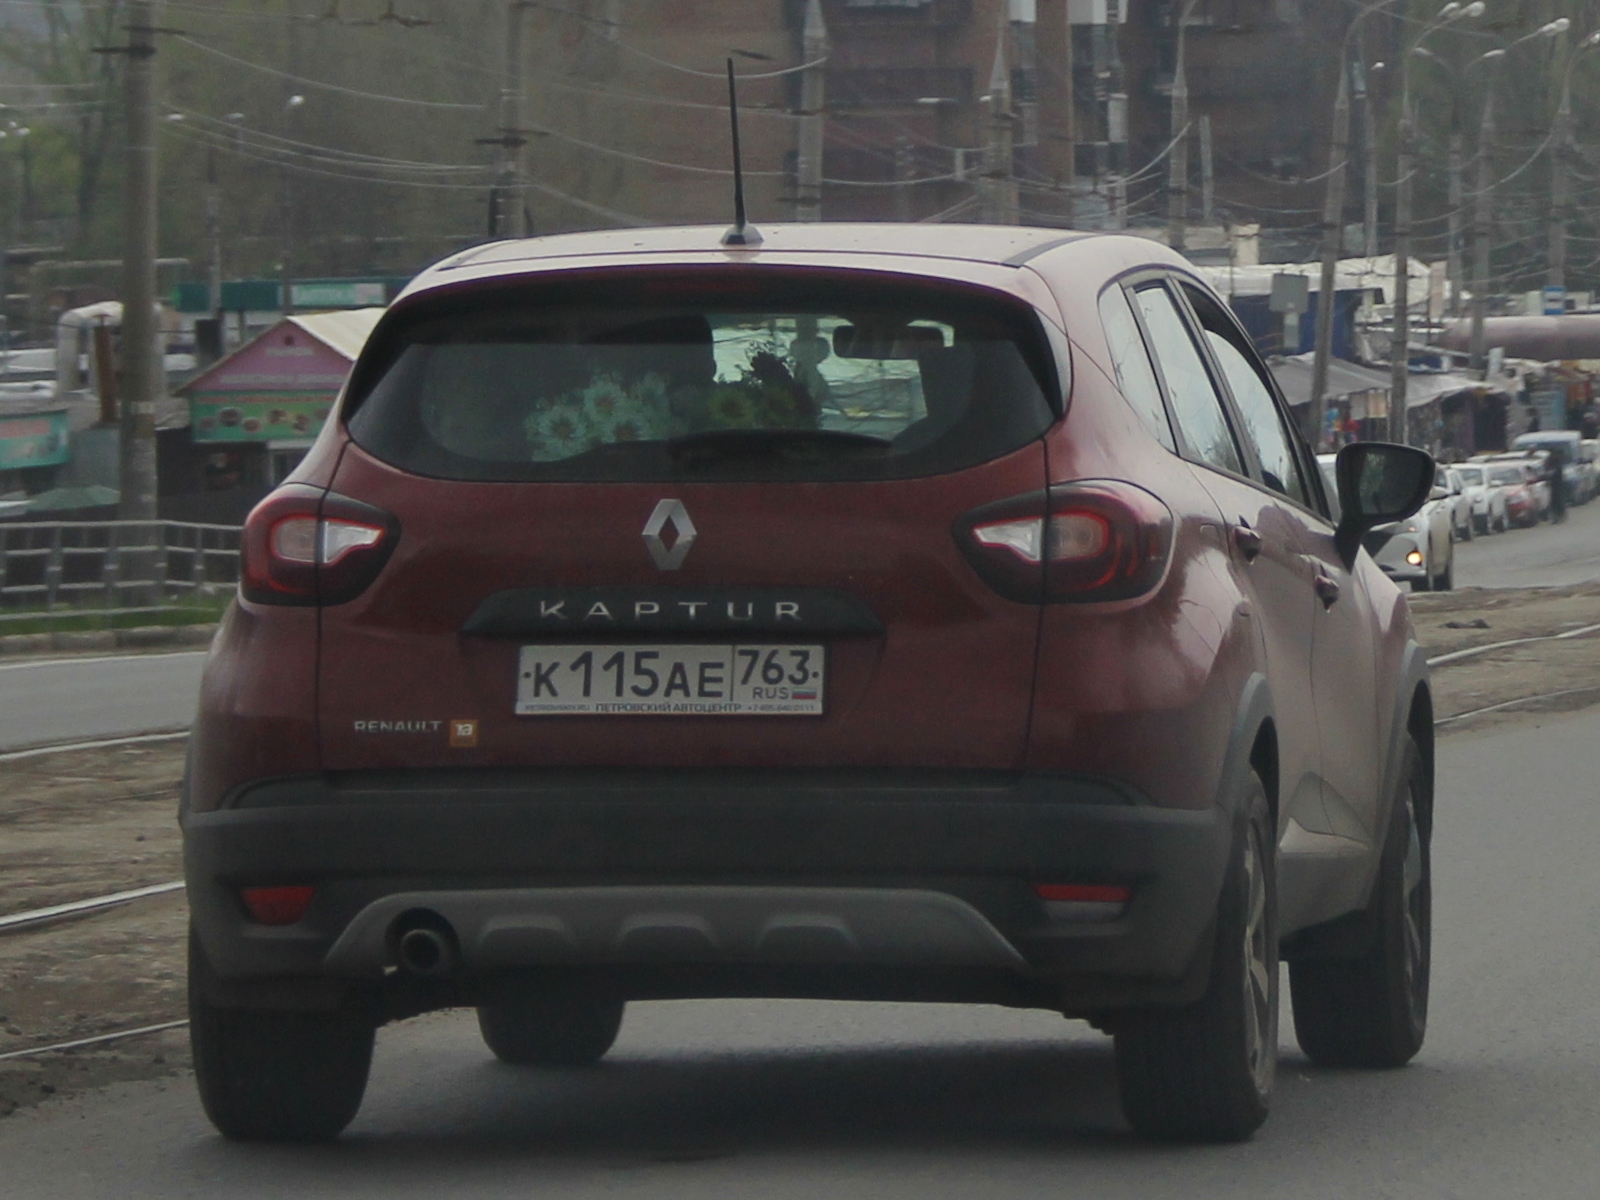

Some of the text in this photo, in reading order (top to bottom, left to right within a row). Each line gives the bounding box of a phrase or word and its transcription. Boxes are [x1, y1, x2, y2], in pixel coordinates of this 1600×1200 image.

[540, 601, 801, 620] KAPTUR
[738, 648, 810, 687] 763
[752, 686, 790, 700] RUS
[595, 702, 742, 713] ПЕТРОВСКИЙ АВТОЦЕНТР
[353, 720, 442, 734] RENAULT
